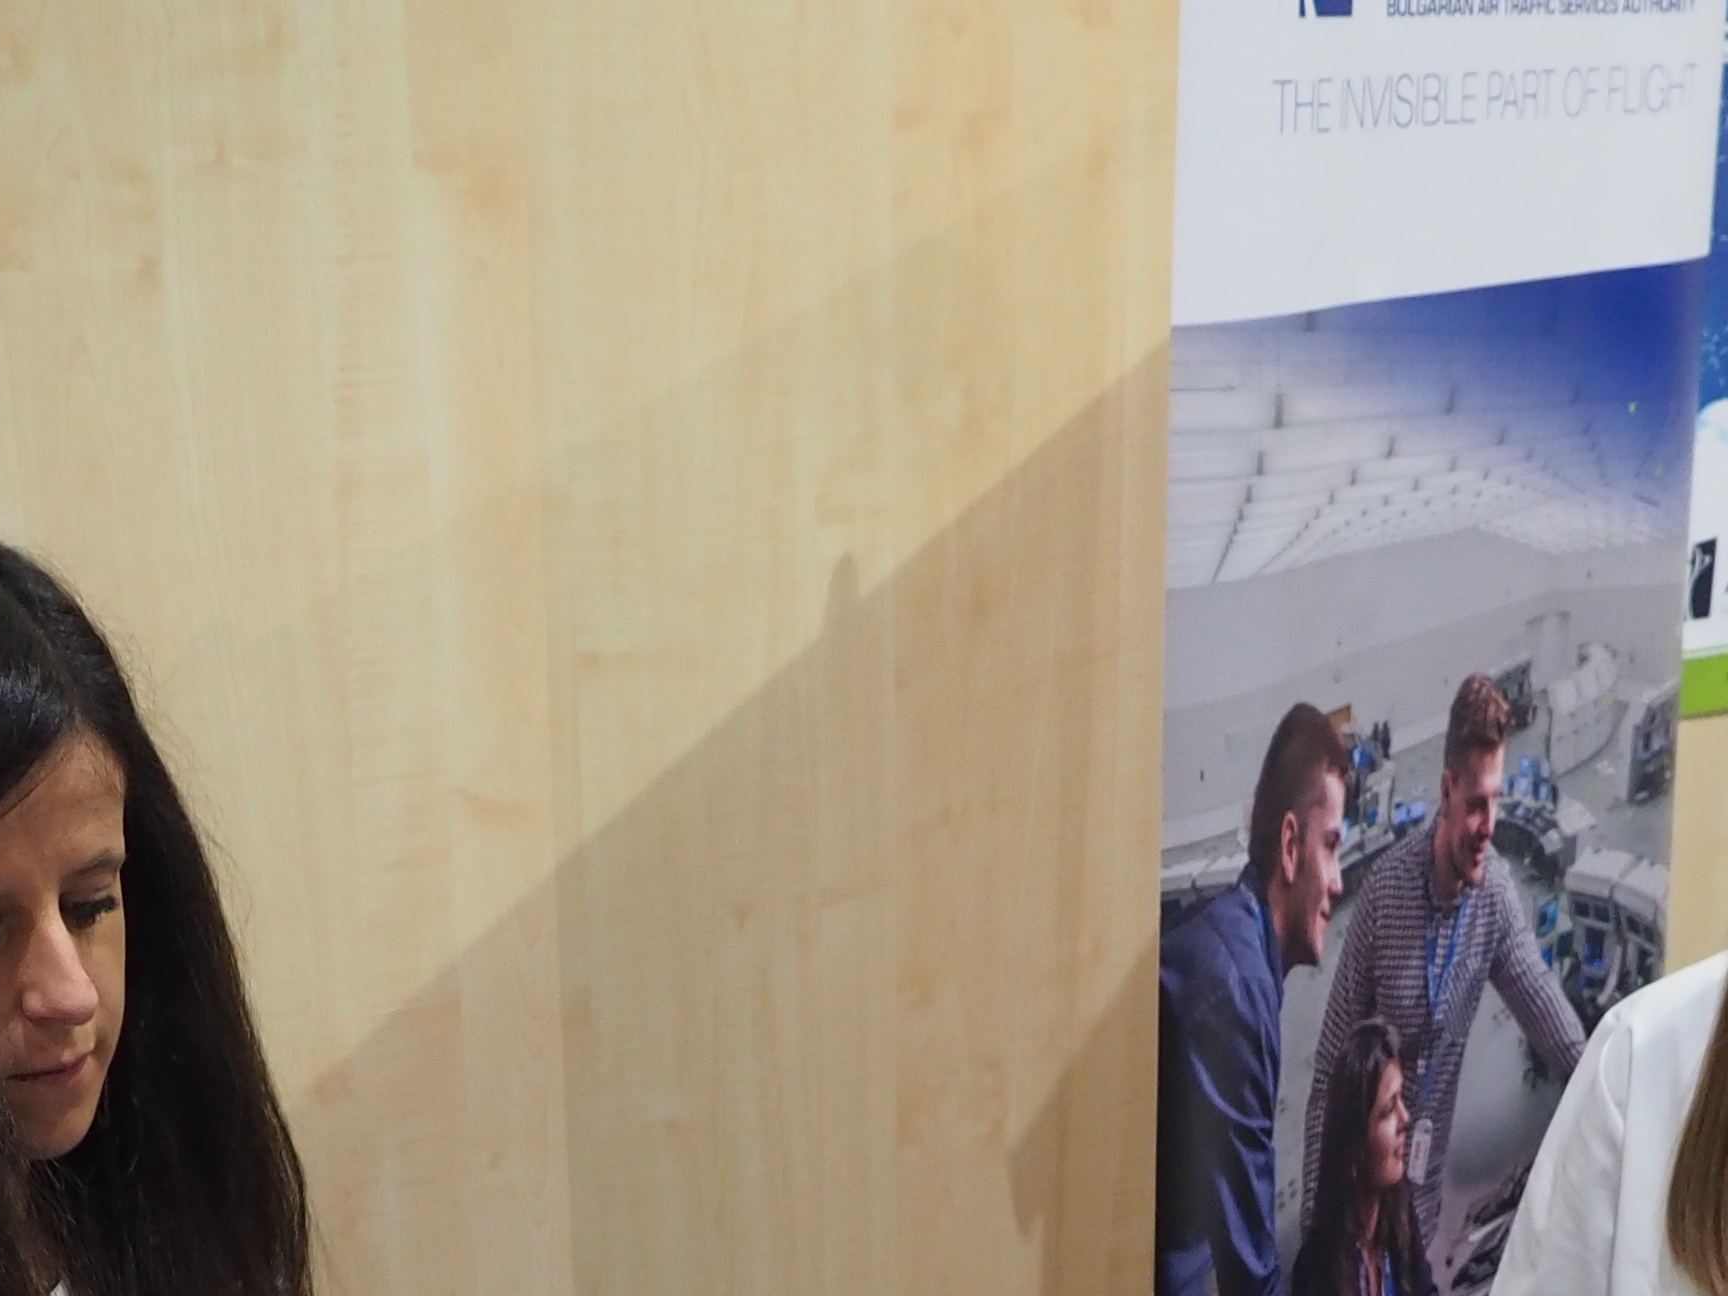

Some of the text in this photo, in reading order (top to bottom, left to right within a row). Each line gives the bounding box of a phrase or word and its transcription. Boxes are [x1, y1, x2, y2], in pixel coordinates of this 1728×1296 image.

[1272, 63, 1698, 135] THE INVISIBLE PART OF FLIGHT
